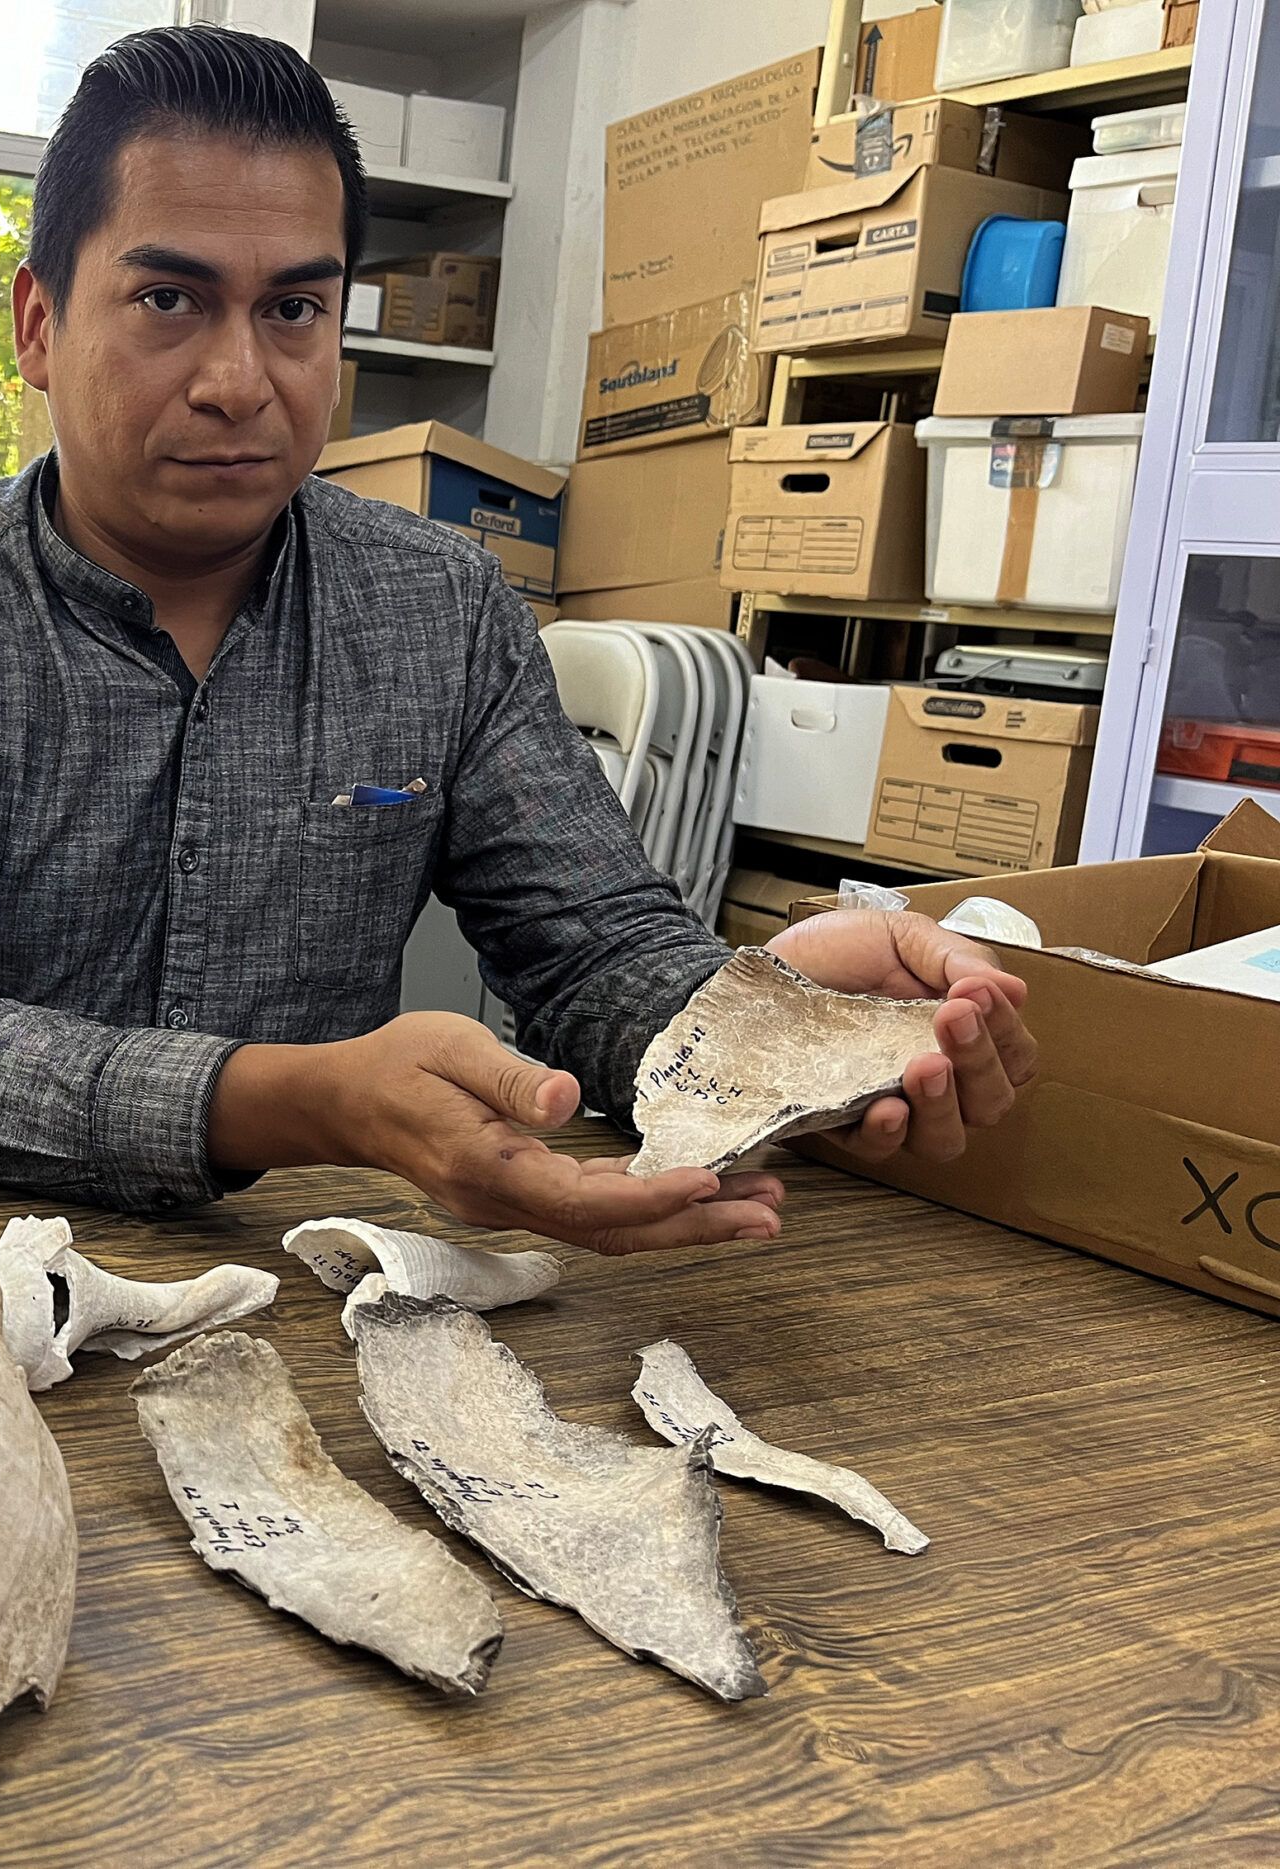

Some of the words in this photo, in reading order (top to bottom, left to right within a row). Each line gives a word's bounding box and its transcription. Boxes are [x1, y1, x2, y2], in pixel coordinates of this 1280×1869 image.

[872, 224, 910, 243] CARTA
[599, 358, 677, 395] Southland
[473, 511, 516, 532] Oxford
